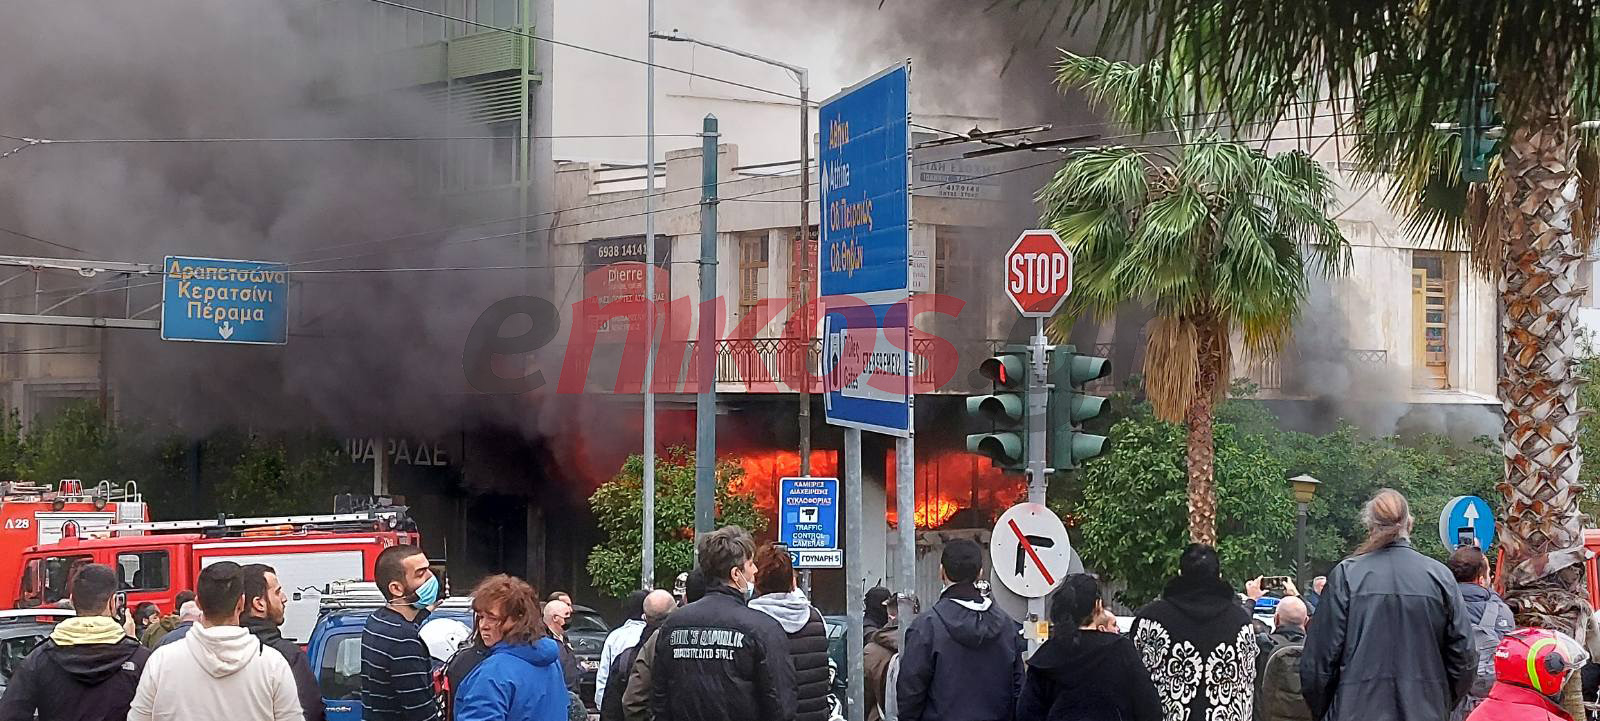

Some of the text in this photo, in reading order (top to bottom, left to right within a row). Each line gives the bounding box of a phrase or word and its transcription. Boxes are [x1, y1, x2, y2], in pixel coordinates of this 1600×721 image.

[829, 113, 849, 154] Αθήνα
[829, 158, 850, 191] Athina
[841, 191, 873, 235] Πειραιώς
[169, 260, 286, 284] Δραπετσώνα
[608, 269, 643, 282] Dierre
[1010, 252, 1066, 294] STOP
[178, 281, 273, 303] Κερατσίνι
[188, 302, 264, 325] Πέραμα
[786, 497, 832, 505] ΚΥΚΛΟΦΟΡΙΑΣ
[715, 648, 736, 660] STYLE
